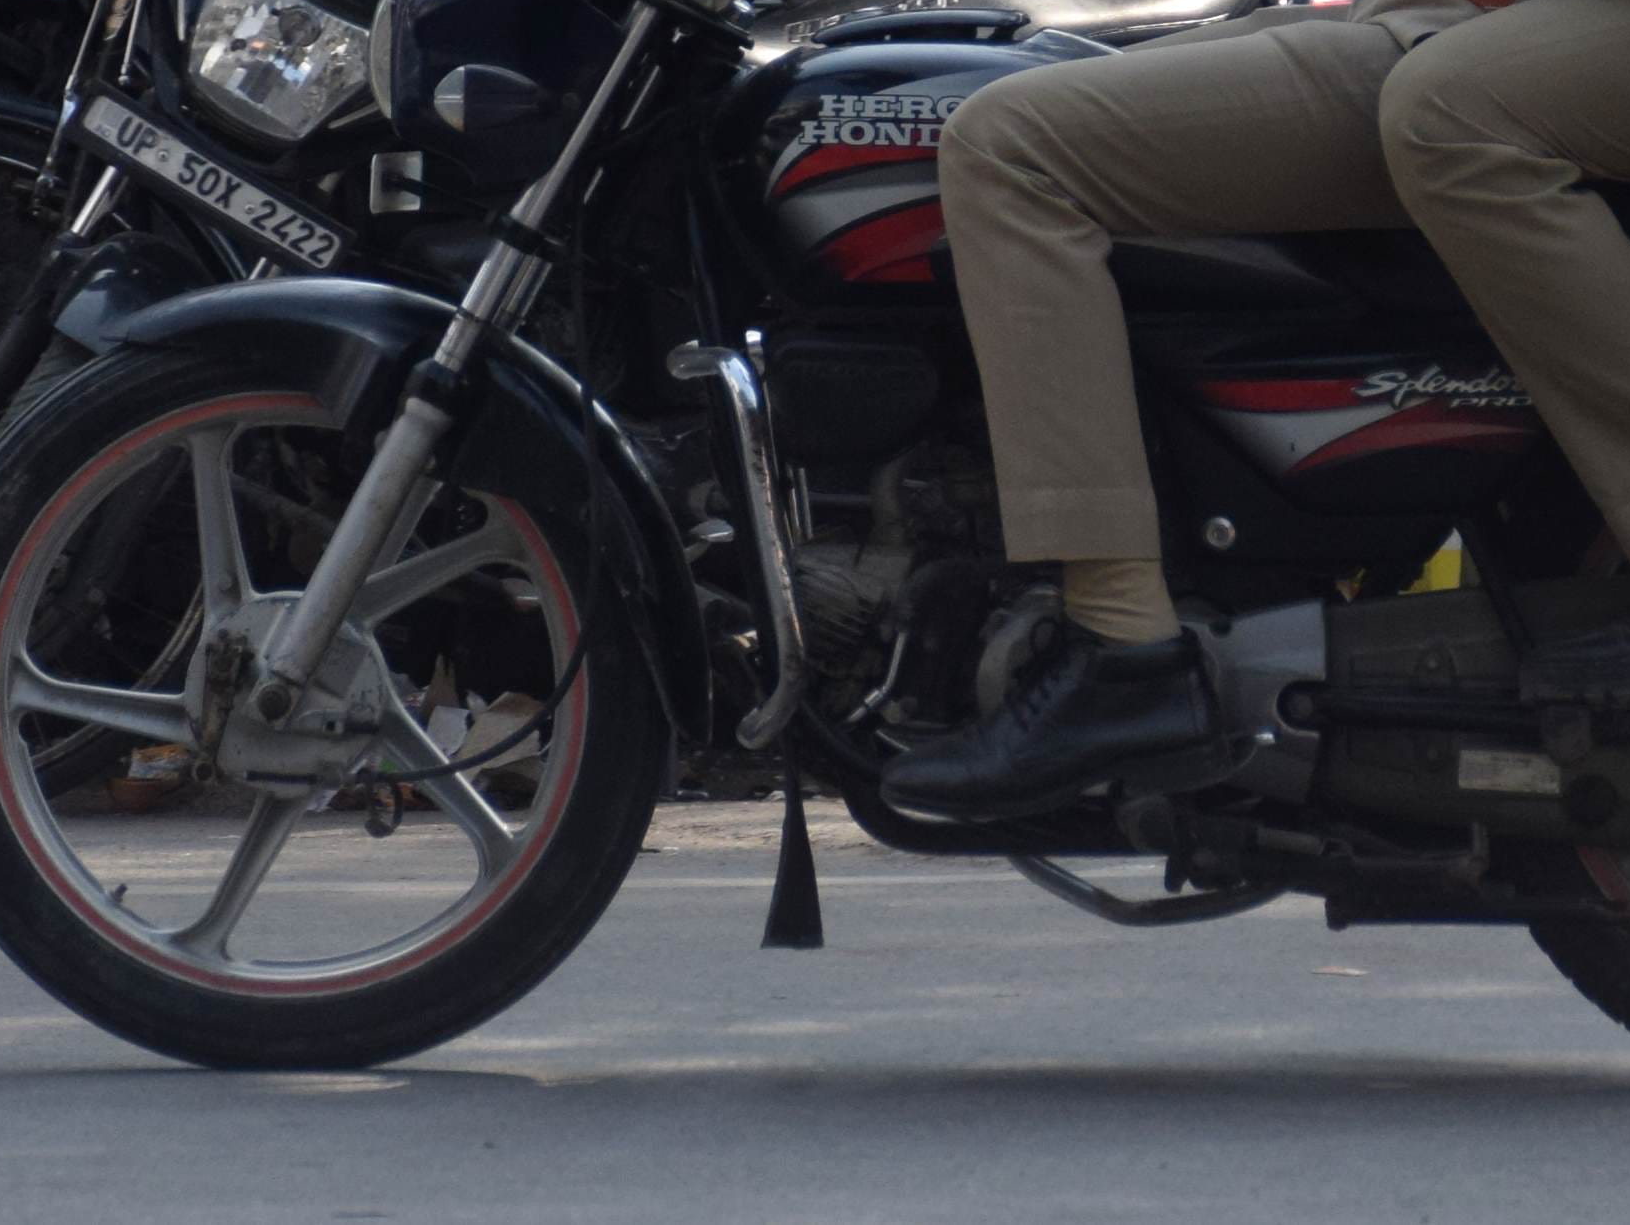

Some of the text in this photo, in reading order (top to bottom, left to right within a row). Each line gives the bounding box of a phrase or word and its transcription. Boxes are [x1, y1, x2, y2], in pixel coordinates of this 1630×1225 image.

[798, 121, 940, 148] HOND
[115, 116, 335, 264] UP 50X 2422
[1353, 365, 1519, 407] Splendo
